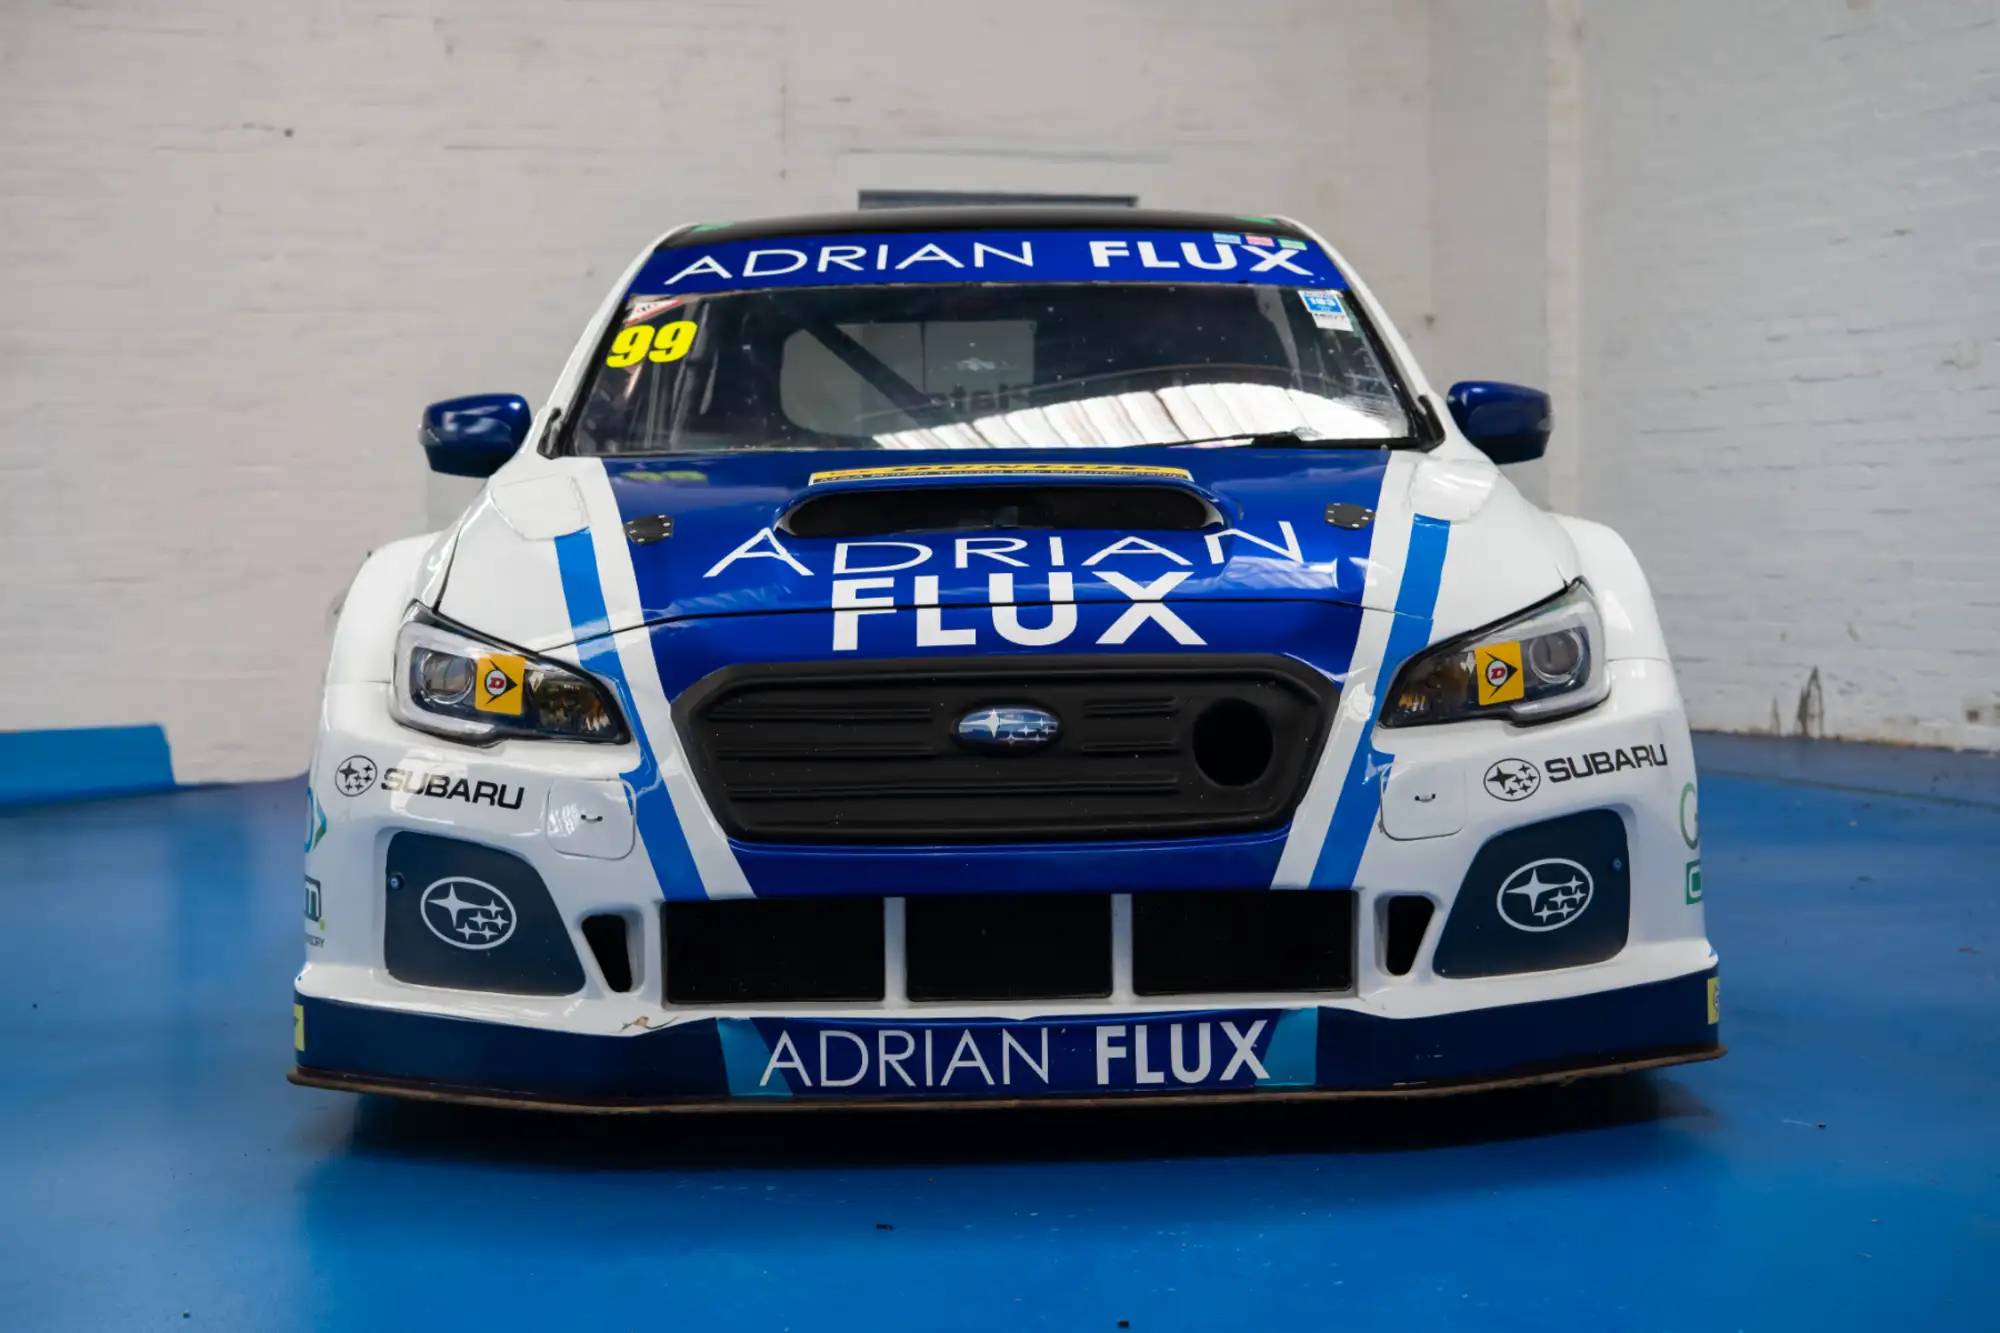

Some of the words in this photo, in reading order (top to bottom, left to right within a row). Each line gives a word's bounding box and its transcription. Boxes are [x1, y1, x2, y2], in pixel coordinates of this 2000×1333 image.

[664, 241, 1034, 285] ADRIAN
[1089, 240, 1314, 276] FLUX
[606, 320, 697, 368] 99
[703, 521, 1304, 577] ADRIAN
[831, 571, 1207, 651] FLUX
[1545, 743, 1668, 784] SUBARU
[381, 767, 525, 810] SUBARU
[759, 1027, 1049, 1087] ADRIAN
[1095, 1020, 1271, 1086] FLUX
